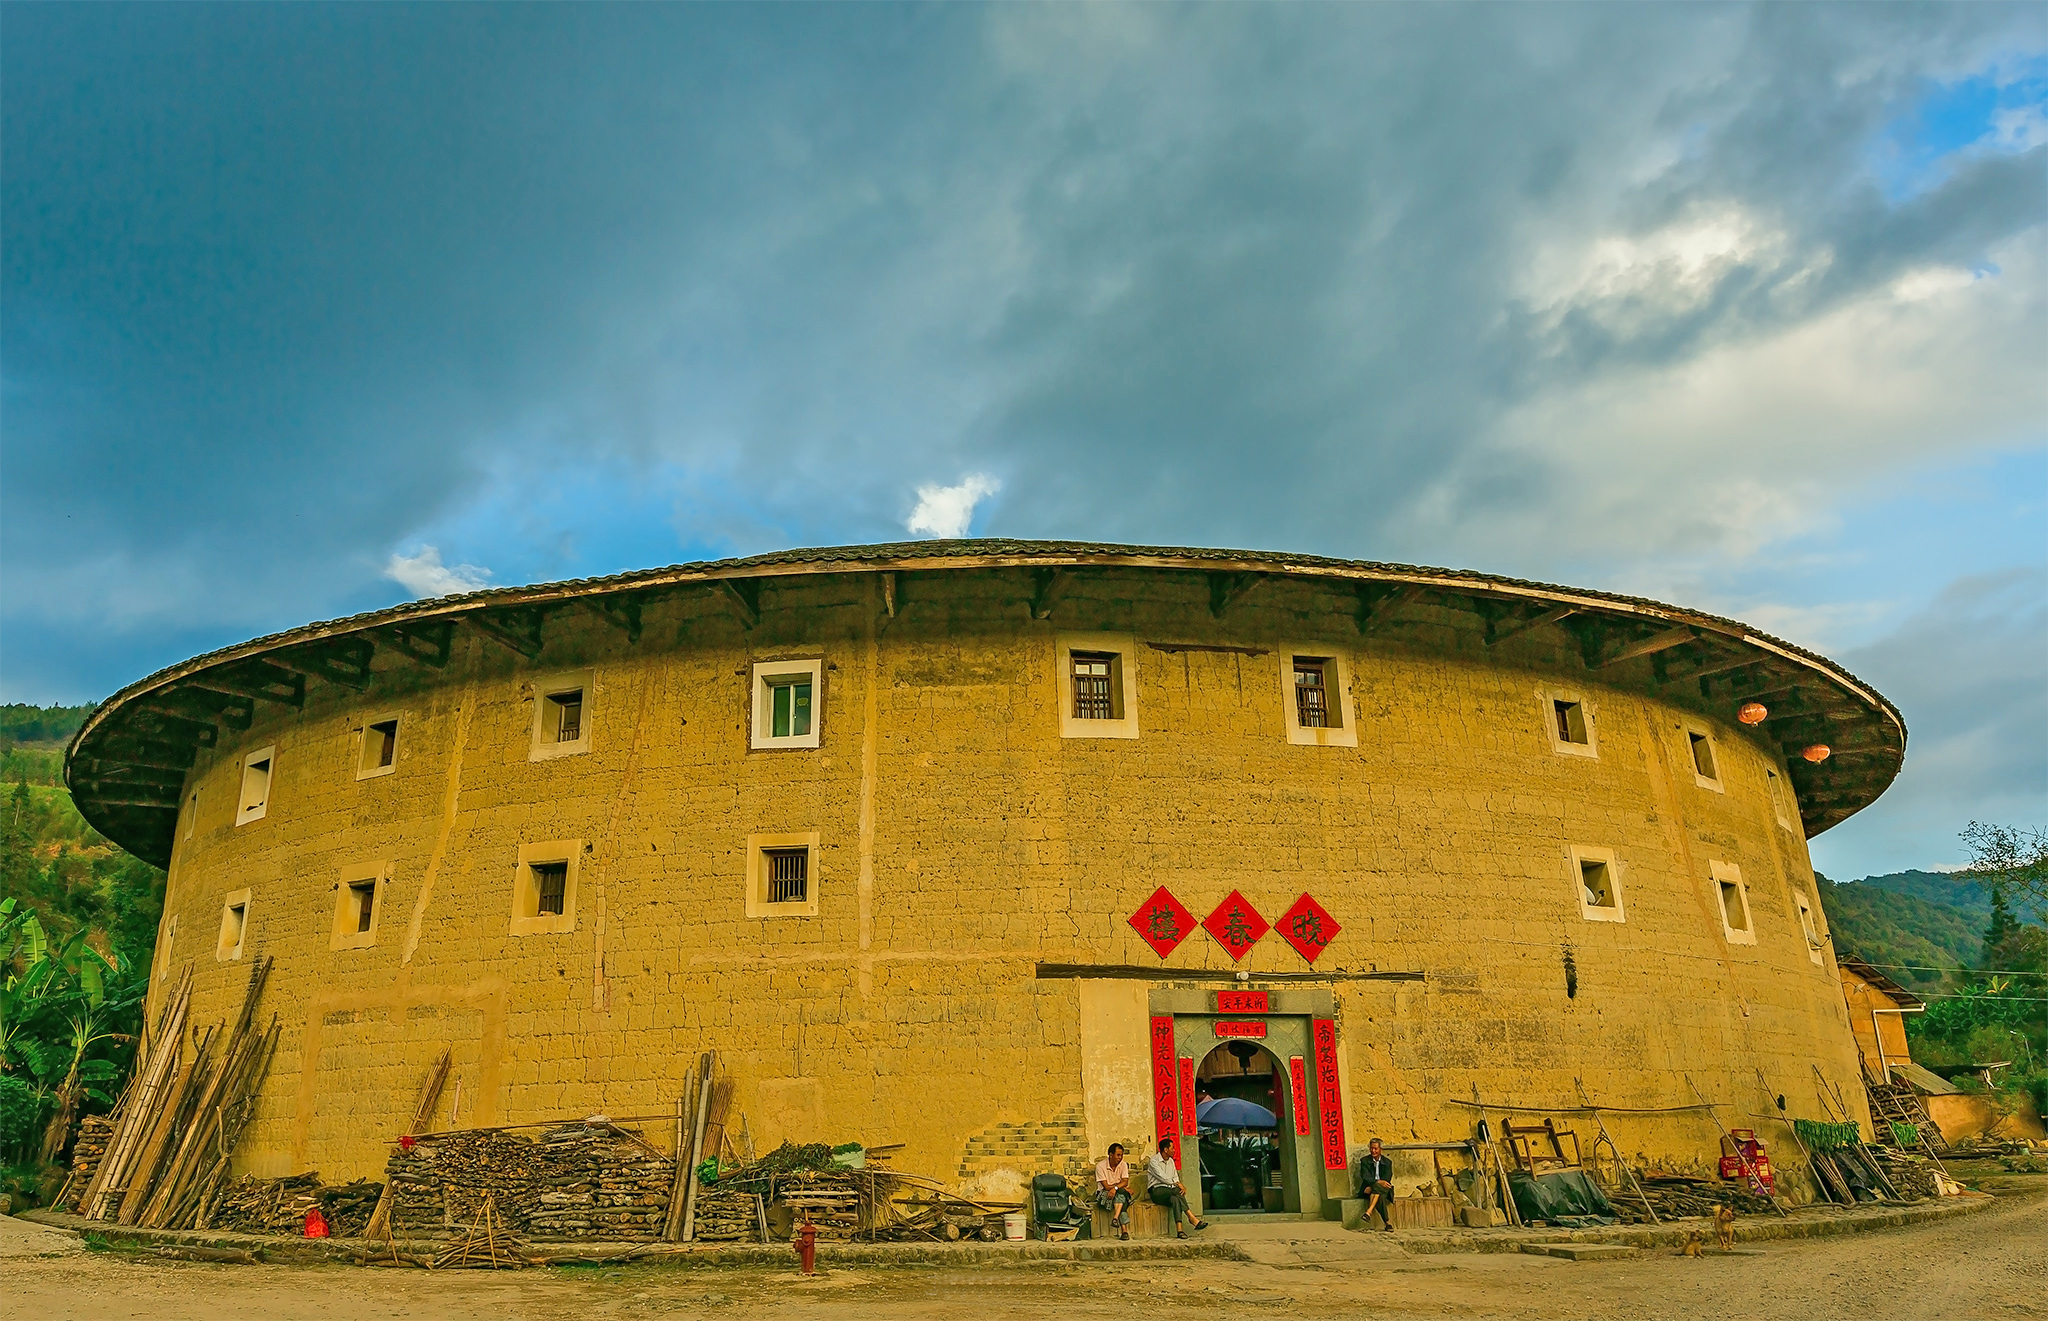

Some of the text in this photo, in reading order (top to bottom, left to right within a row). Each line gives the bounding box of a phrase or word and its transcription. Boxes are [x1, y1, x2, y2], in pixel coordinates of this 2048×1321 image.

[1155, 1022, 1178, 1163] 神光入户纳千
